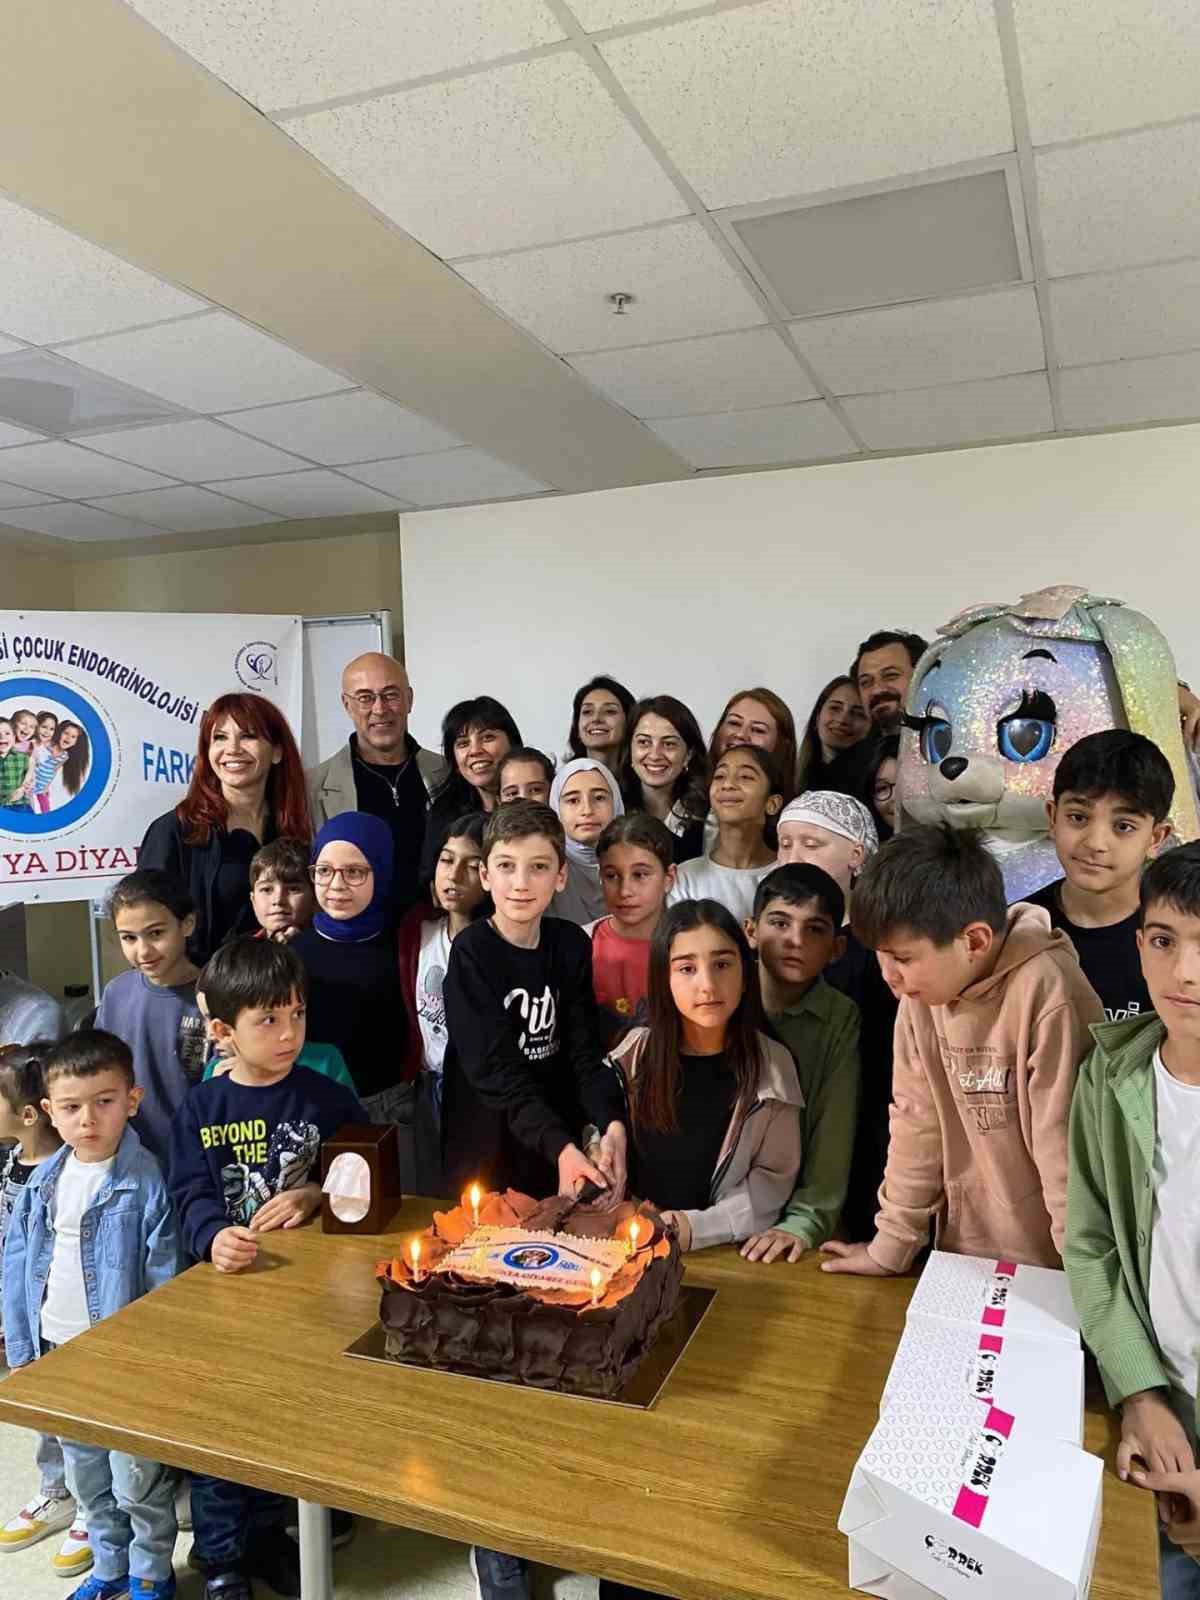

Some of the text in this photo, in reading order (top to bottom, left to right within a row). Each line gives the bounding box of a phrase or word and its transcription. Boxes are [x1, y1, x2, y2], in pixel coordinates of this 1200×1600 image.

[13, 636, 66, 664] ÇOCUK
[68, 644, 199, 724] ENDOKRİNOLOJİSİ
[200, 1119, 267, 1149] BEYOND
[232, 1142, 268, 1166] THE
